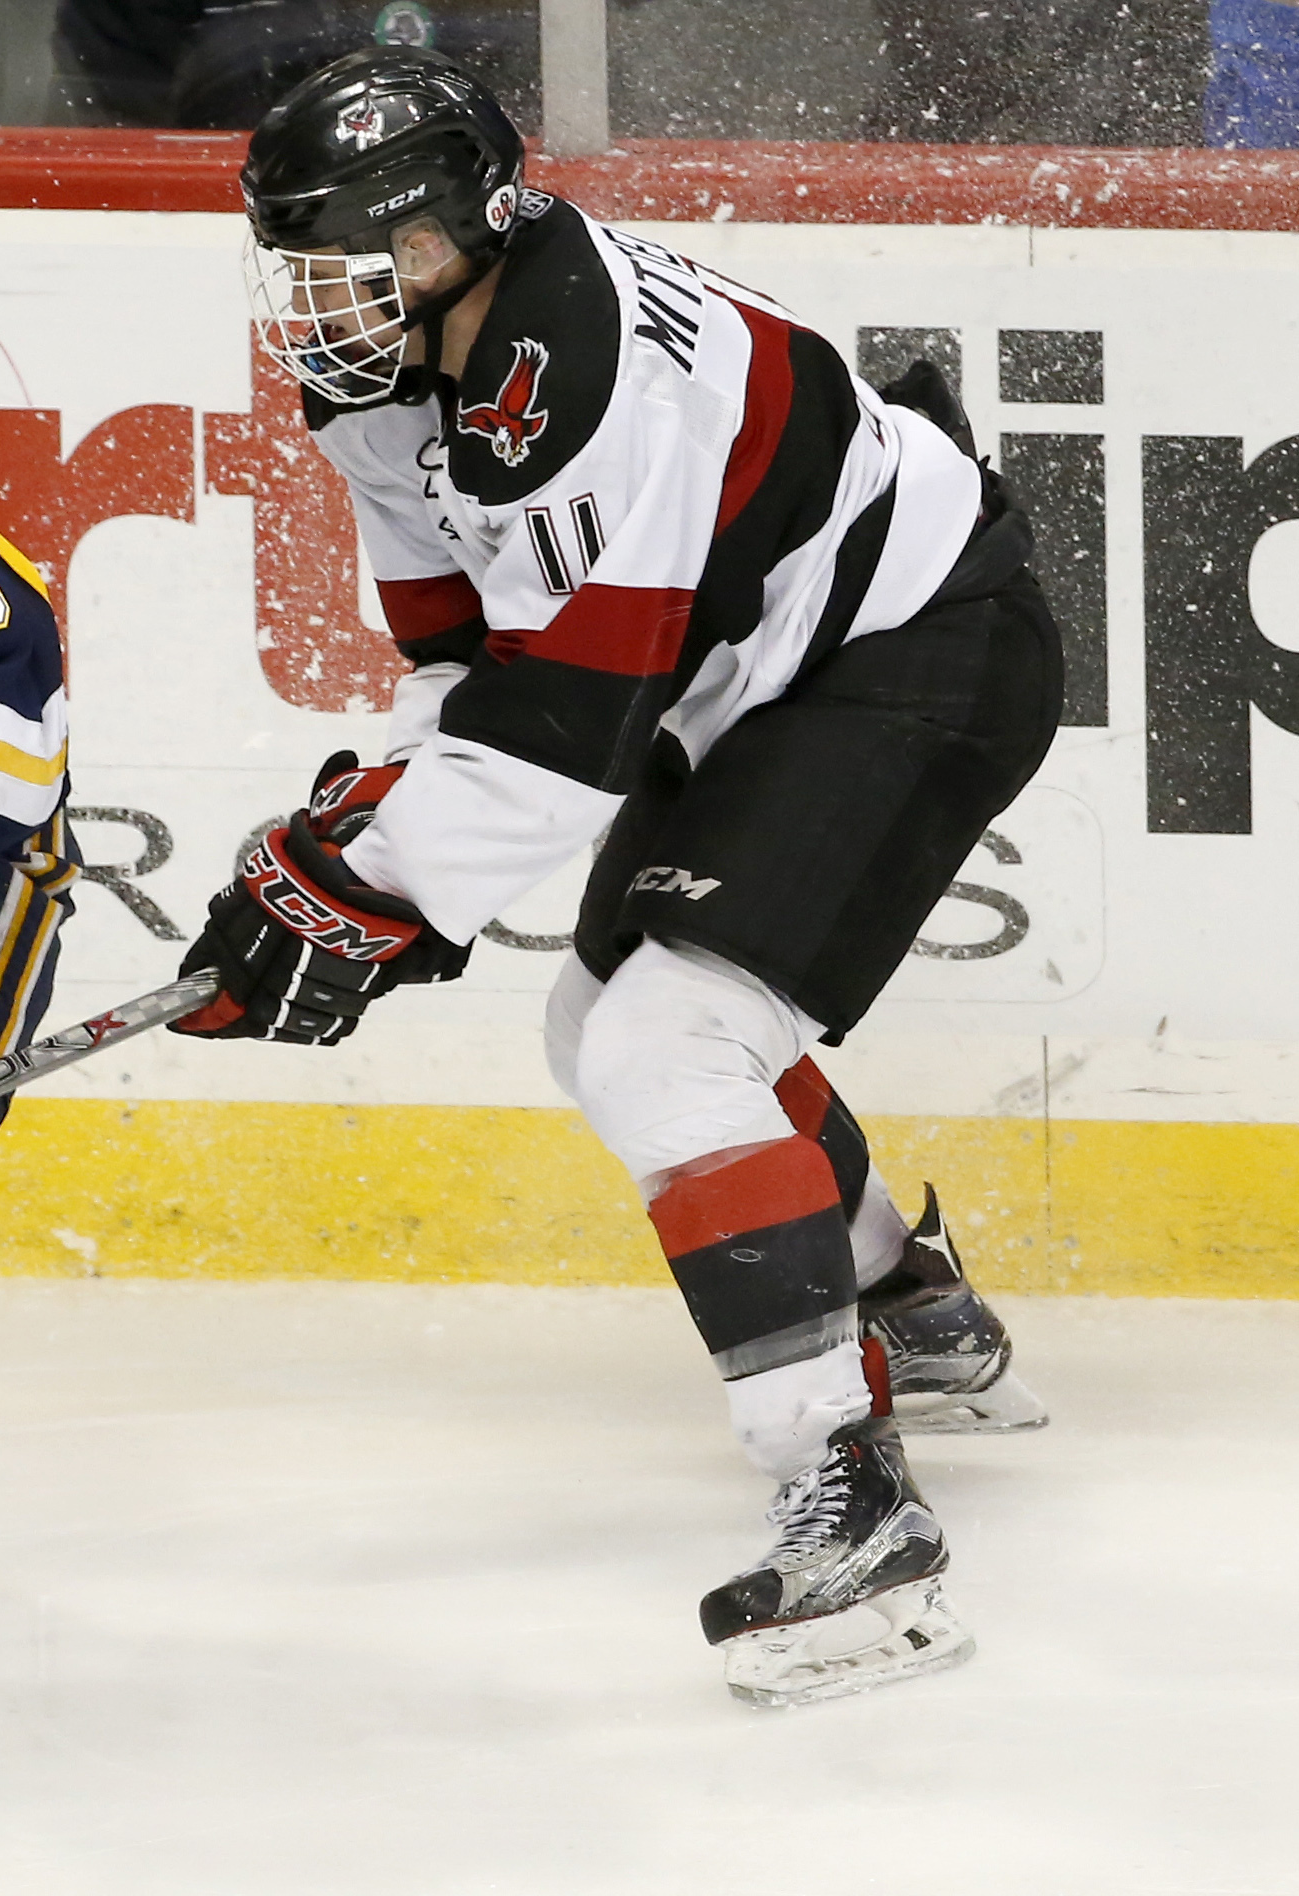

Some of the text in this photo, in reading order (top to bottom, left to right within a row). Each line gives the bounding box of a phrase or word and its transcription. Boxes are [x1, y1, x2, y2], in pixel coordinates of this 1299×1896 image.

[524, 491, 607, 596] 11
[242, 846, 402, 962] CCM
[625, 865, 723, 901] CM
